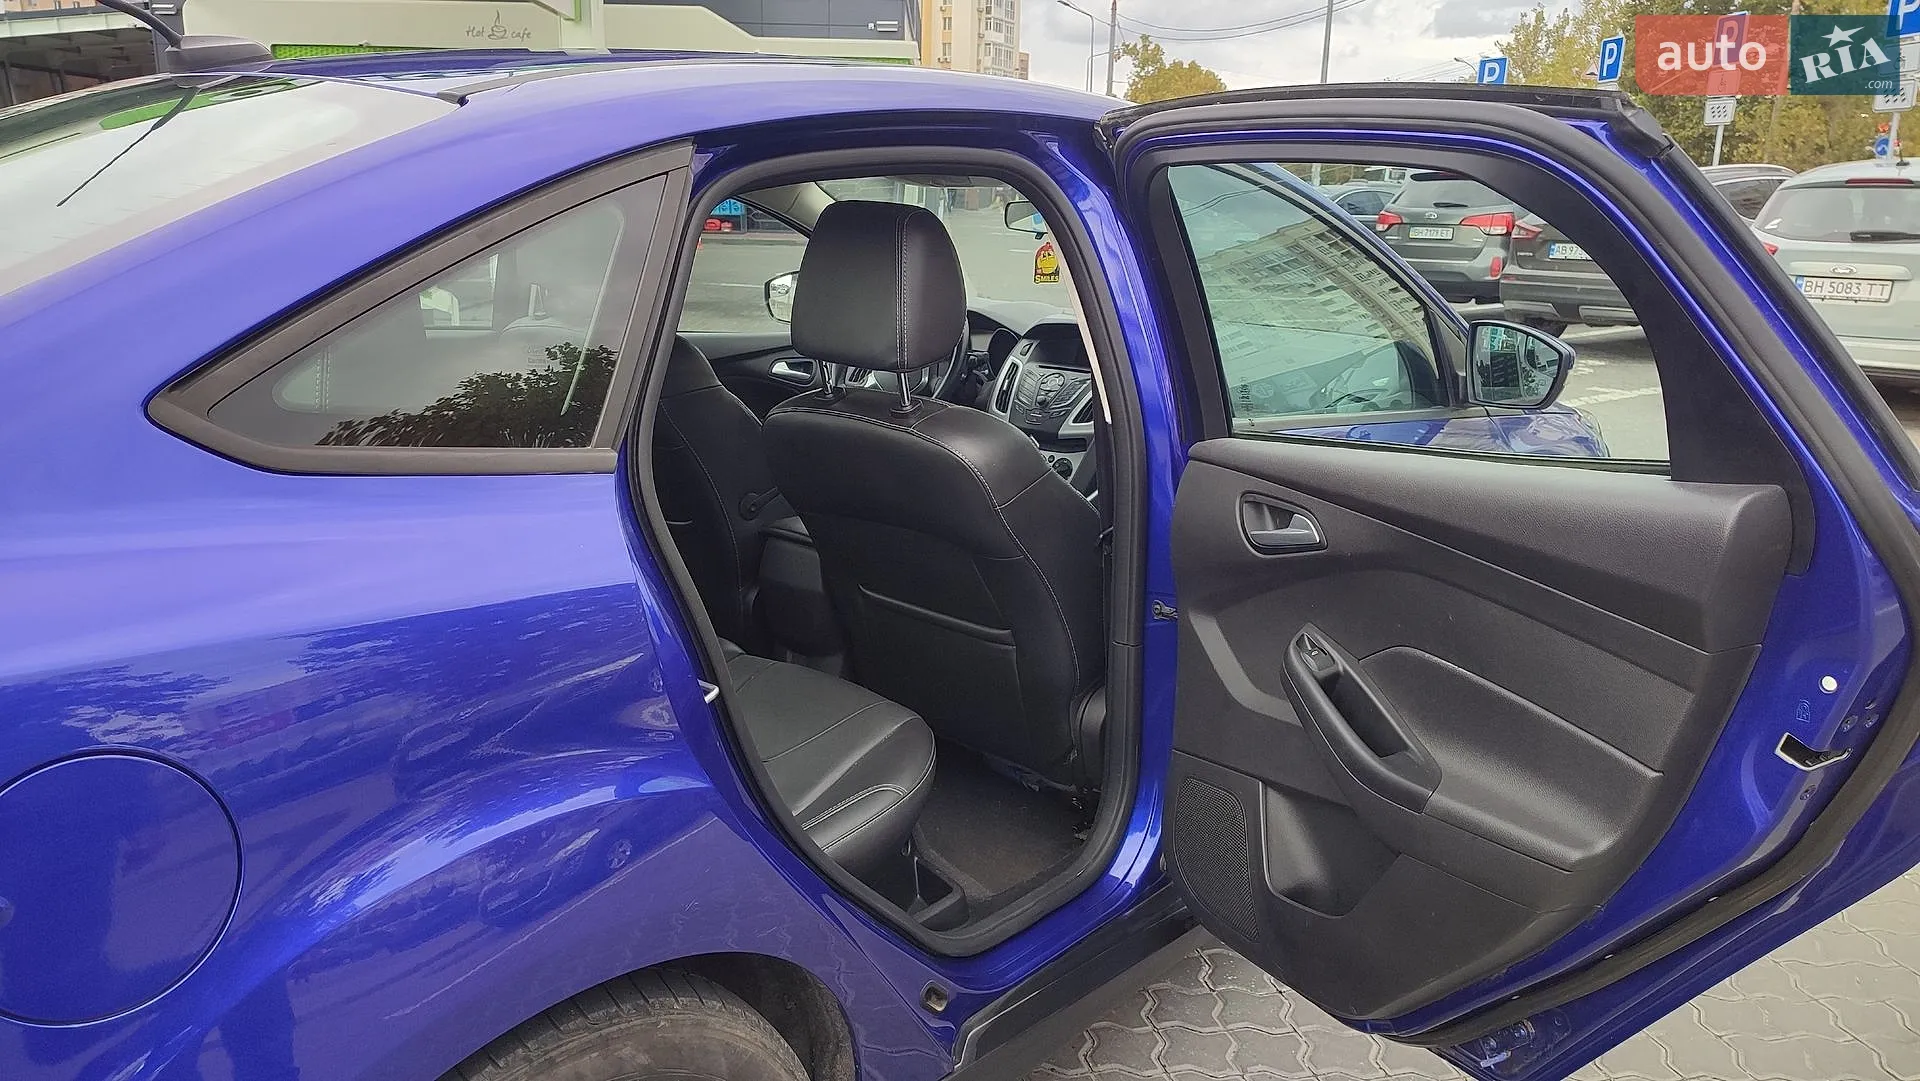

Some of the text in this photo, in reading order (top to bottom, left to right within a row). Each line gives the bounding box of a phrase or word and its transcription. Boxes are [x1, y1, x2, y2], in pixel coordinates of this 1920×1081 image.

[1602, 42, 1618, 77] P
[1482, 62, 1500, 84] P
[1803, 280, 1889, 297] BH 5083 TT
